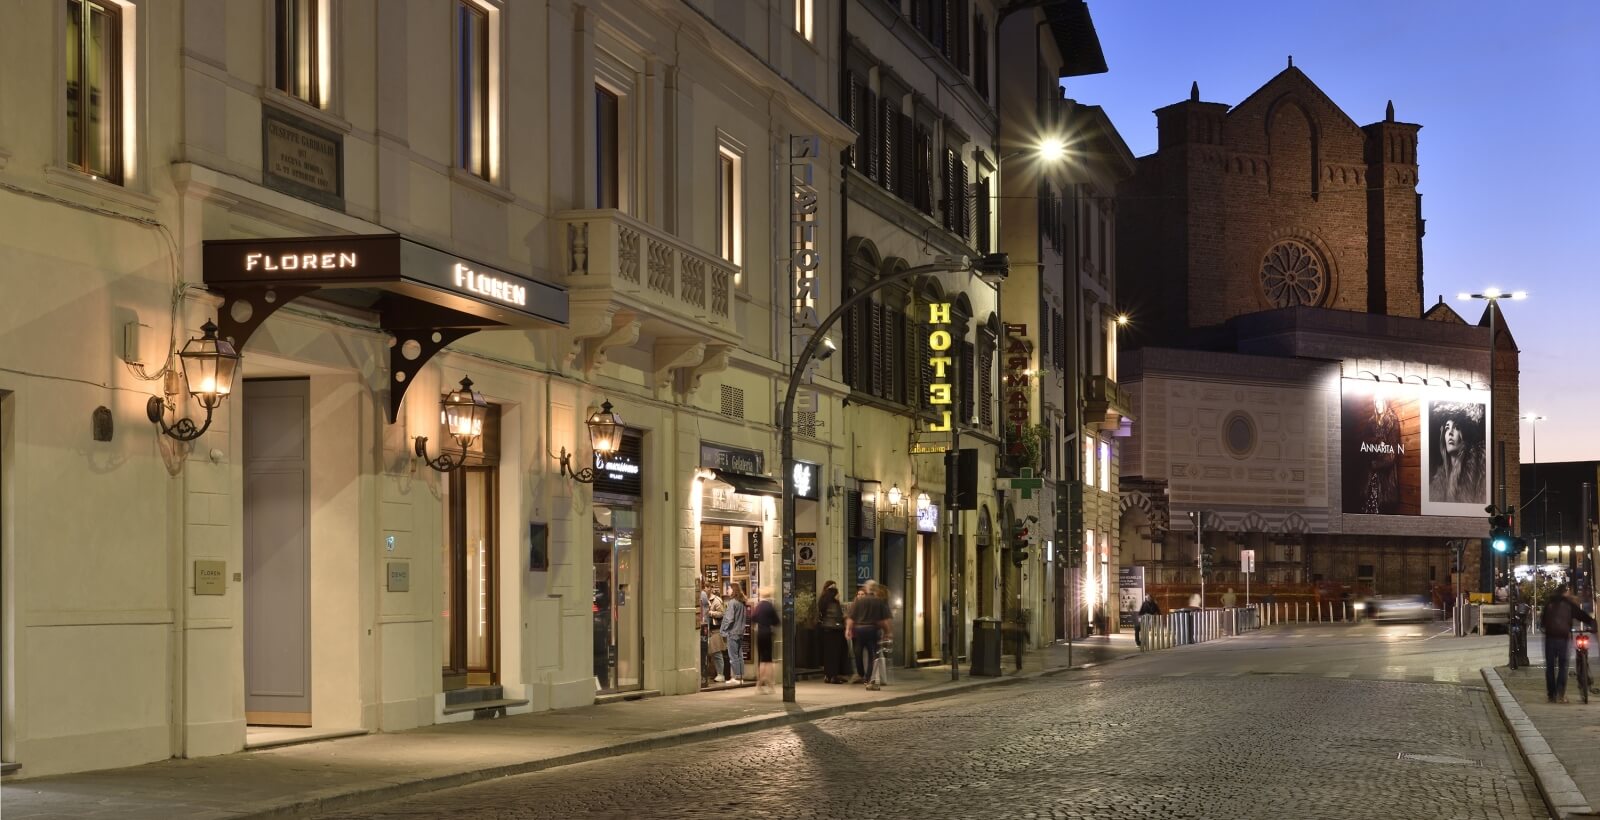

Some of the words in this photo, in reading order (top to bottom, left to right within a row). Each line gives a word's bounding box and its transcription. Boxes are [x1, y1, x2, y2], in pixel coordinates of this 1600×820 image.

[246, 252, 356, 271] FLOREN
[455, 263, 526, 306] FLOREN
[1397, 443, 1405, 455] N
[858, 566, 870, 579] 20
